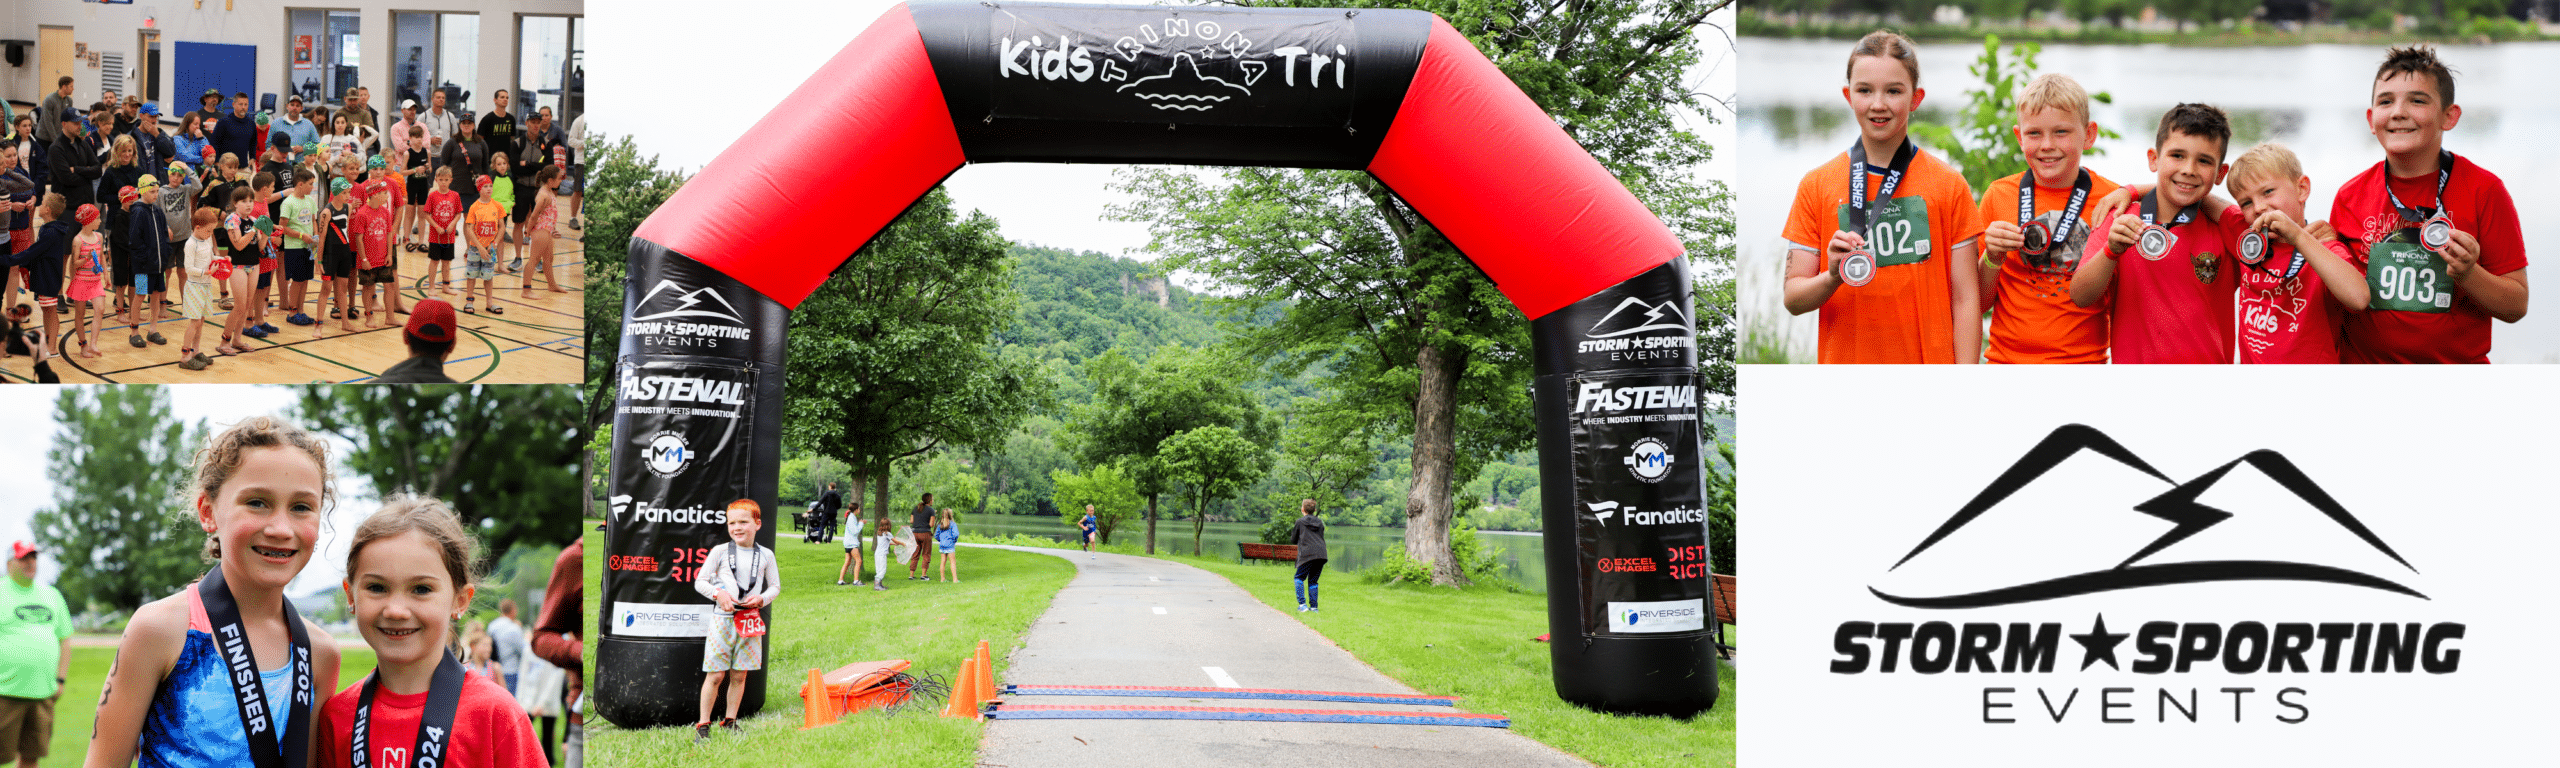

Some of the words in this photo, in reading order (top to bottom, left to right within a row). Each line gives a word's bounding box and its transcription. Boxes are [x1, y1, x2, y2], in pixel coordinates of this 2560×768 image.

[1000, 35, 1094, 83] Kids
[1100, 18, 1267, 86] TRINONA
[1274, 44, 1347, 89] Tri
[493, 123, 512, 133] NIKE
[1852, 161, 1864, 209] FINISHER
[1881, 169, 1901, 195] 2024
[2053, 188, 2086, 243] FINISHER
[2379, 265, 2436, 303] 903
[2244, 304, 2278, 333] Kids
[626, 322, 662, 336] STORM
[675, 322, 751, 341] SPORTING
[645, 336, 717, 348] EVENTS
[1578, 338, 1630, 353] STORM
[1611, 349, 1679, 361] EVENTS
[620, 369, 745, 406] FASTENAL
[1575, 382, 1698, 413] FASTENAL
[631, 406, 665, 415] INDUSTRY
[666, 407, 690, 416] MEETS
[691, 408, 736, 419] INNOVATION
[1582, 416, 1606, 425] WHERE
[1607, 415, 1643, 424] INDUSTRY
[1644, 414, 1666, 422] MEETS
[649, 430, 670, 443] MORRIE
[671, 430, 690, 446] MILLER
[1630, 437, 1651, 450] MORRIE
[634, 501, 727, 525] Fanatics
[1623, 504, 1704, 526] Fanatics
[623, 556, 658, 565] EXCEL
[673, 547, 712, 564] DIS
[1614, 557, 1656, 566] EXCEL
[1668, 545, 1705, 562] DIST
[622, 563, 658, 572] IMAGES
[1669, 562, 1706, 580] RICT
[636, 612, 700, 621] RIVERSIDE
[1640, 607, 1696, 618] RIVERSIDE
[740, 618, 761, 635] 793
[220, 622, 267, 736] FINISHER
[296, 646, 309, 706] 2024
[418, 725, 445, 768] 024
